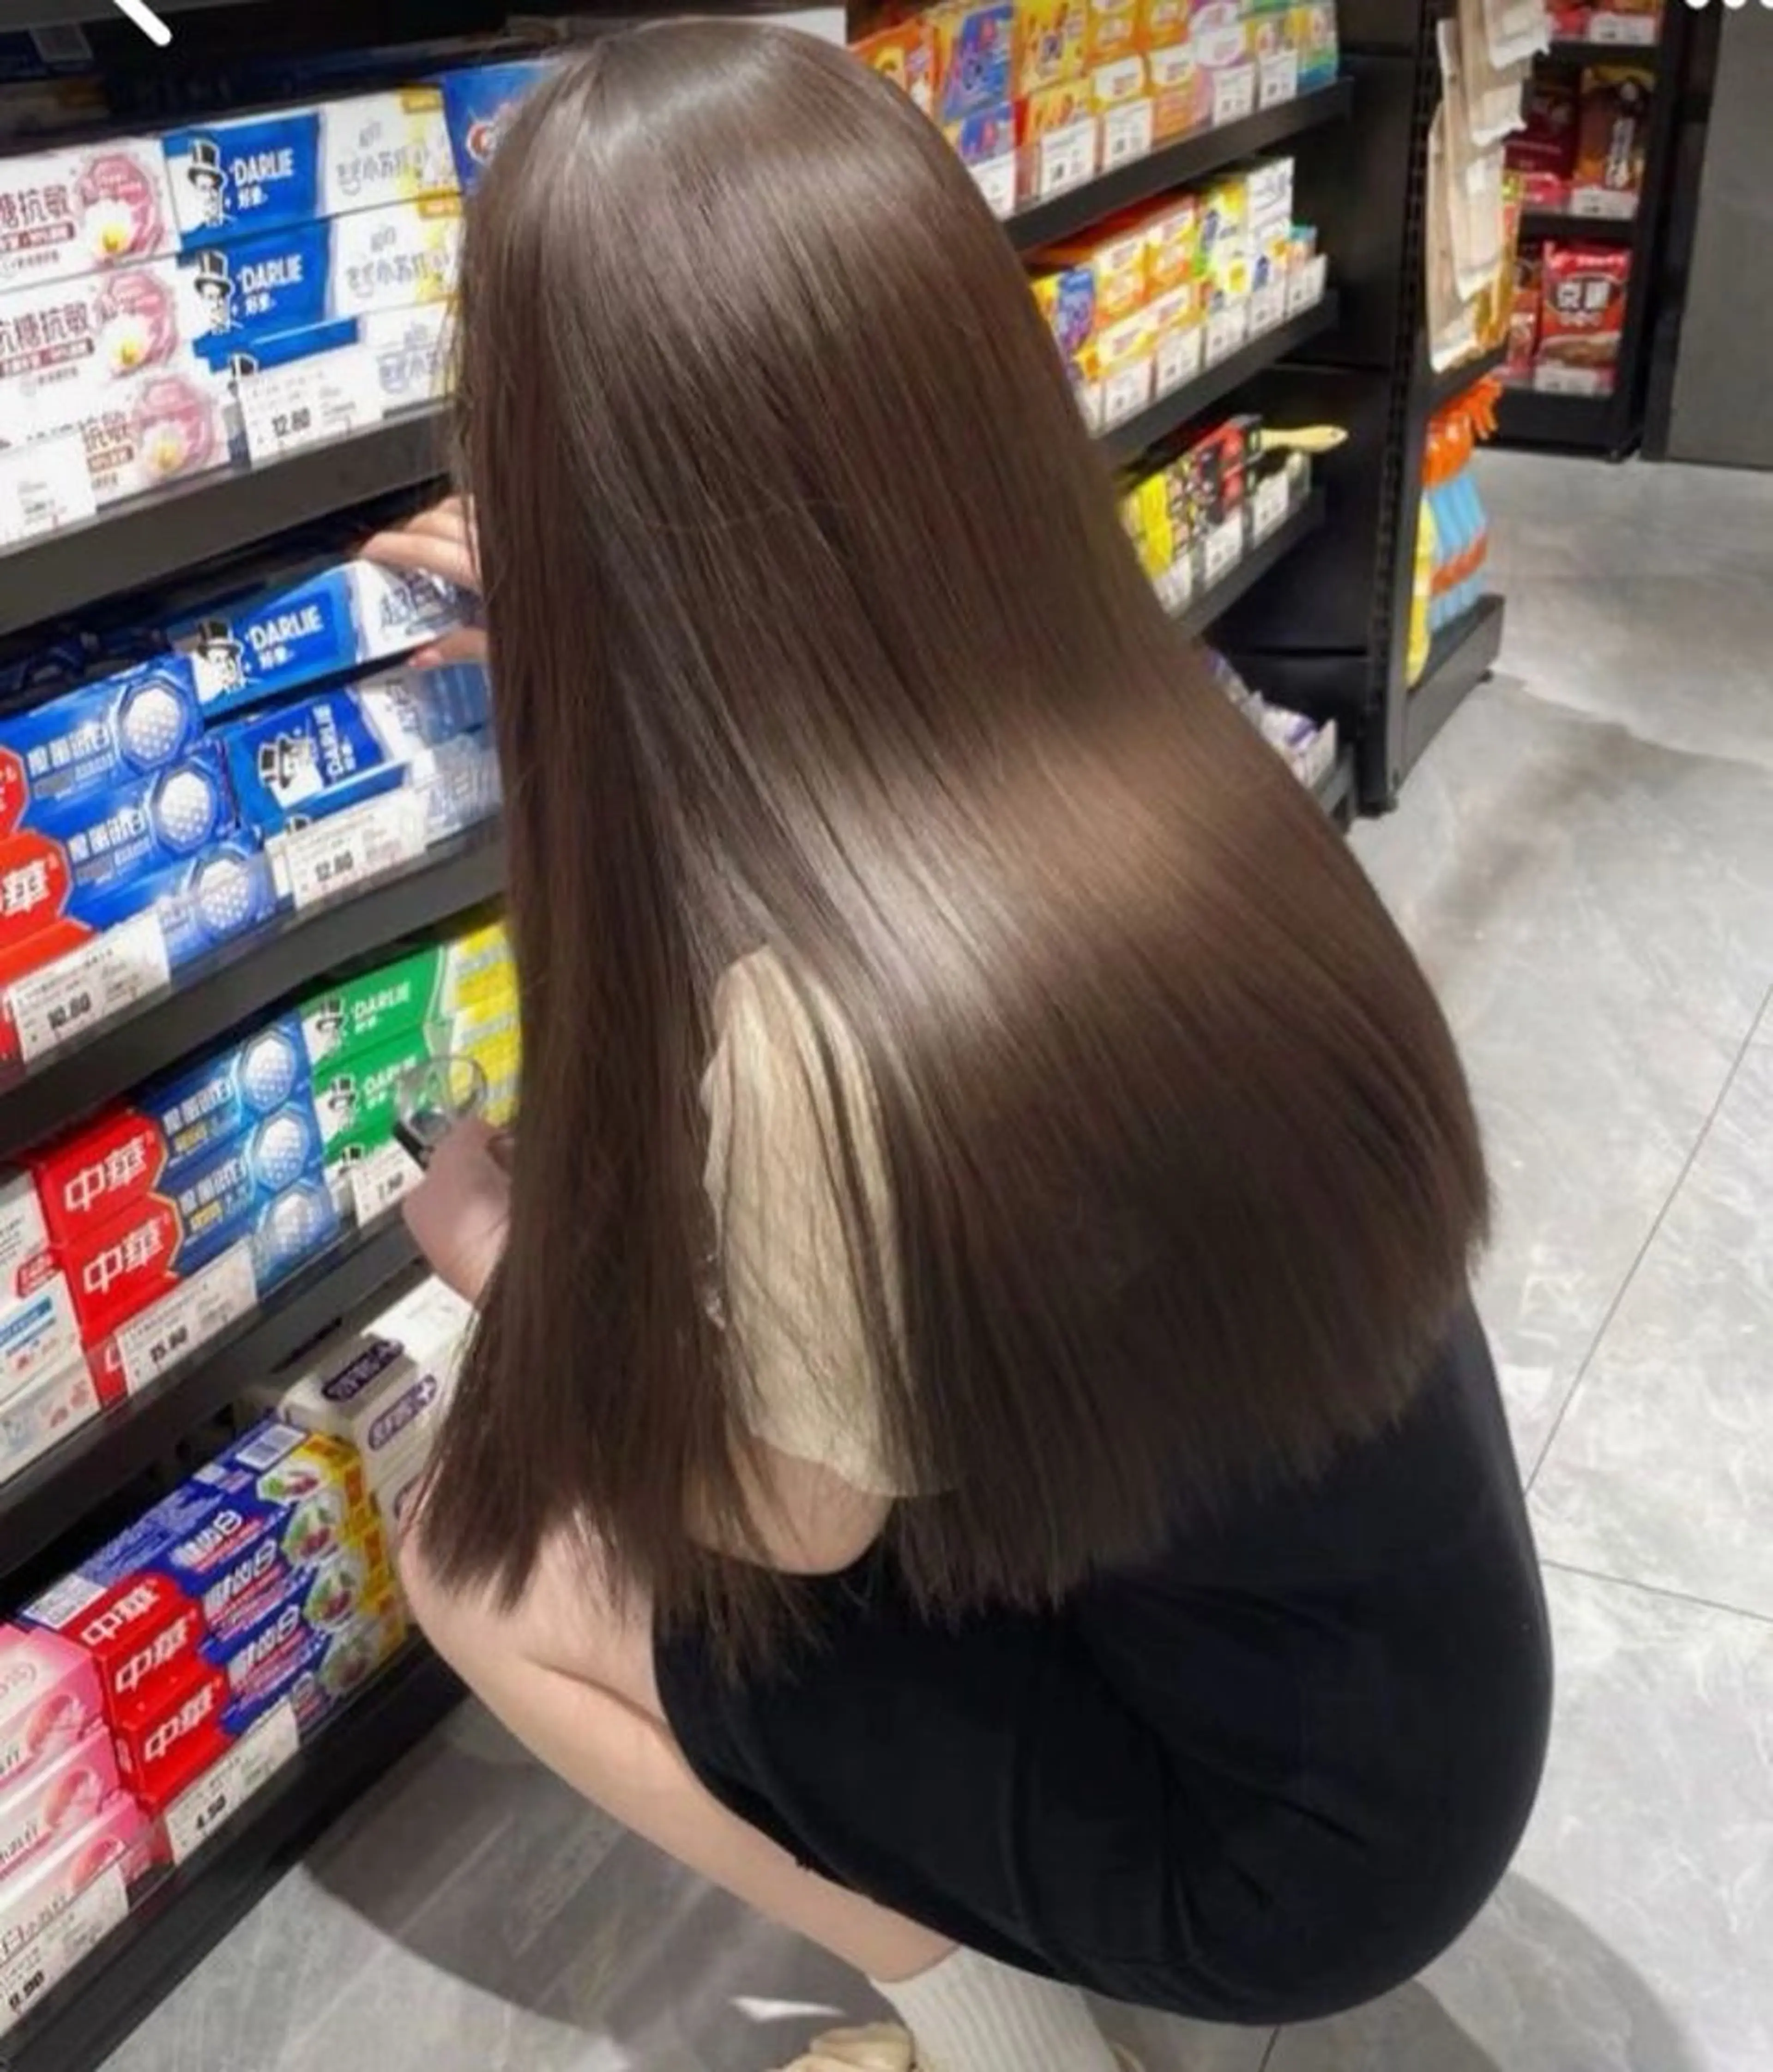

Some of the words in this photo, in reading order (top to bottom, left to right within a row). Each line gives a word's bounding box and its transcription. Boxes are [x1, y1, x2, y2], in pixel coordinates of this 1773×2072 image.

[234, 147, 295, 187] DARLIE
[242, 254, 303, 295] DARLIE
[249, 605, 325, 652] DARLIE
